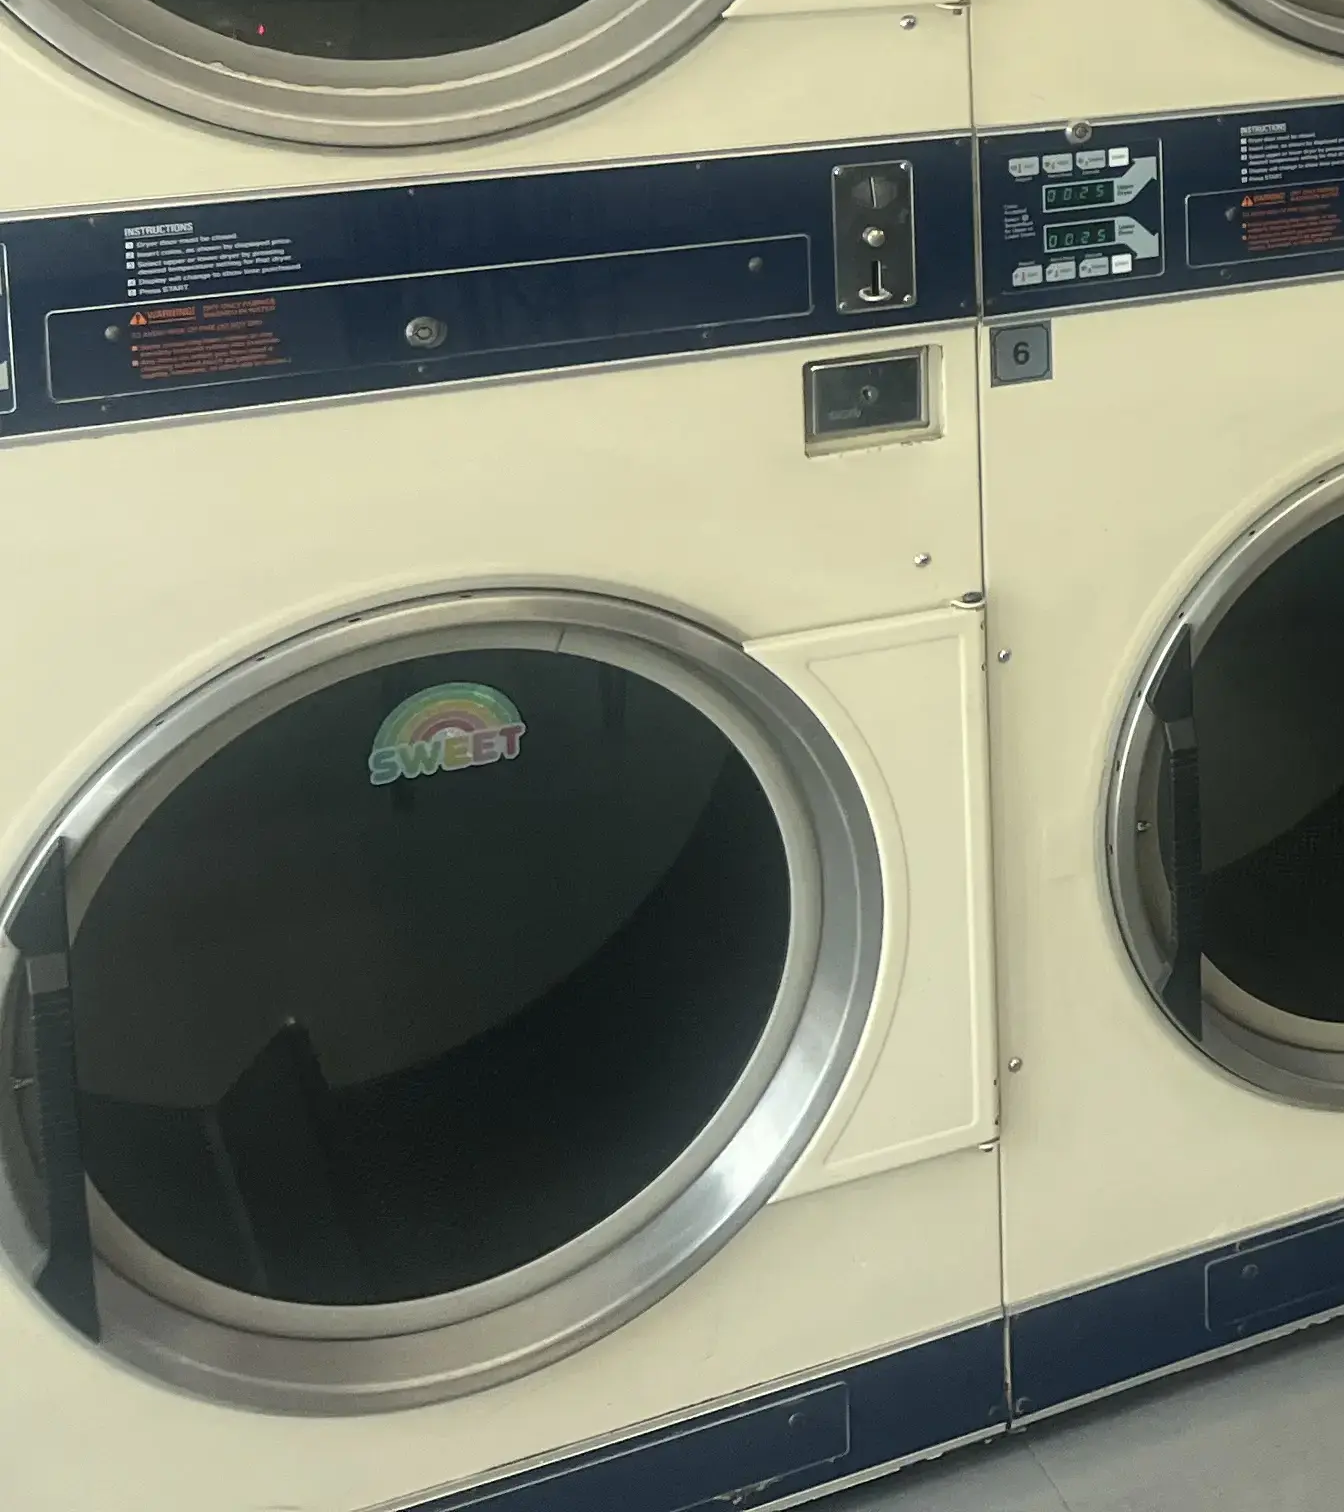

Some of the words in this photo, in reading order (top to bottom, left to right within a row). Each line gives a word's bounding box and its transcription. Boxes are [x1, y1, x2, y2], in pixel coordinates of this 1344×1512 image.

[124, 222, 194, 238] INSTRUCTIONS
[1013, 341, 1030, 366] 6
[370, 723, 525, 784] SWEET
